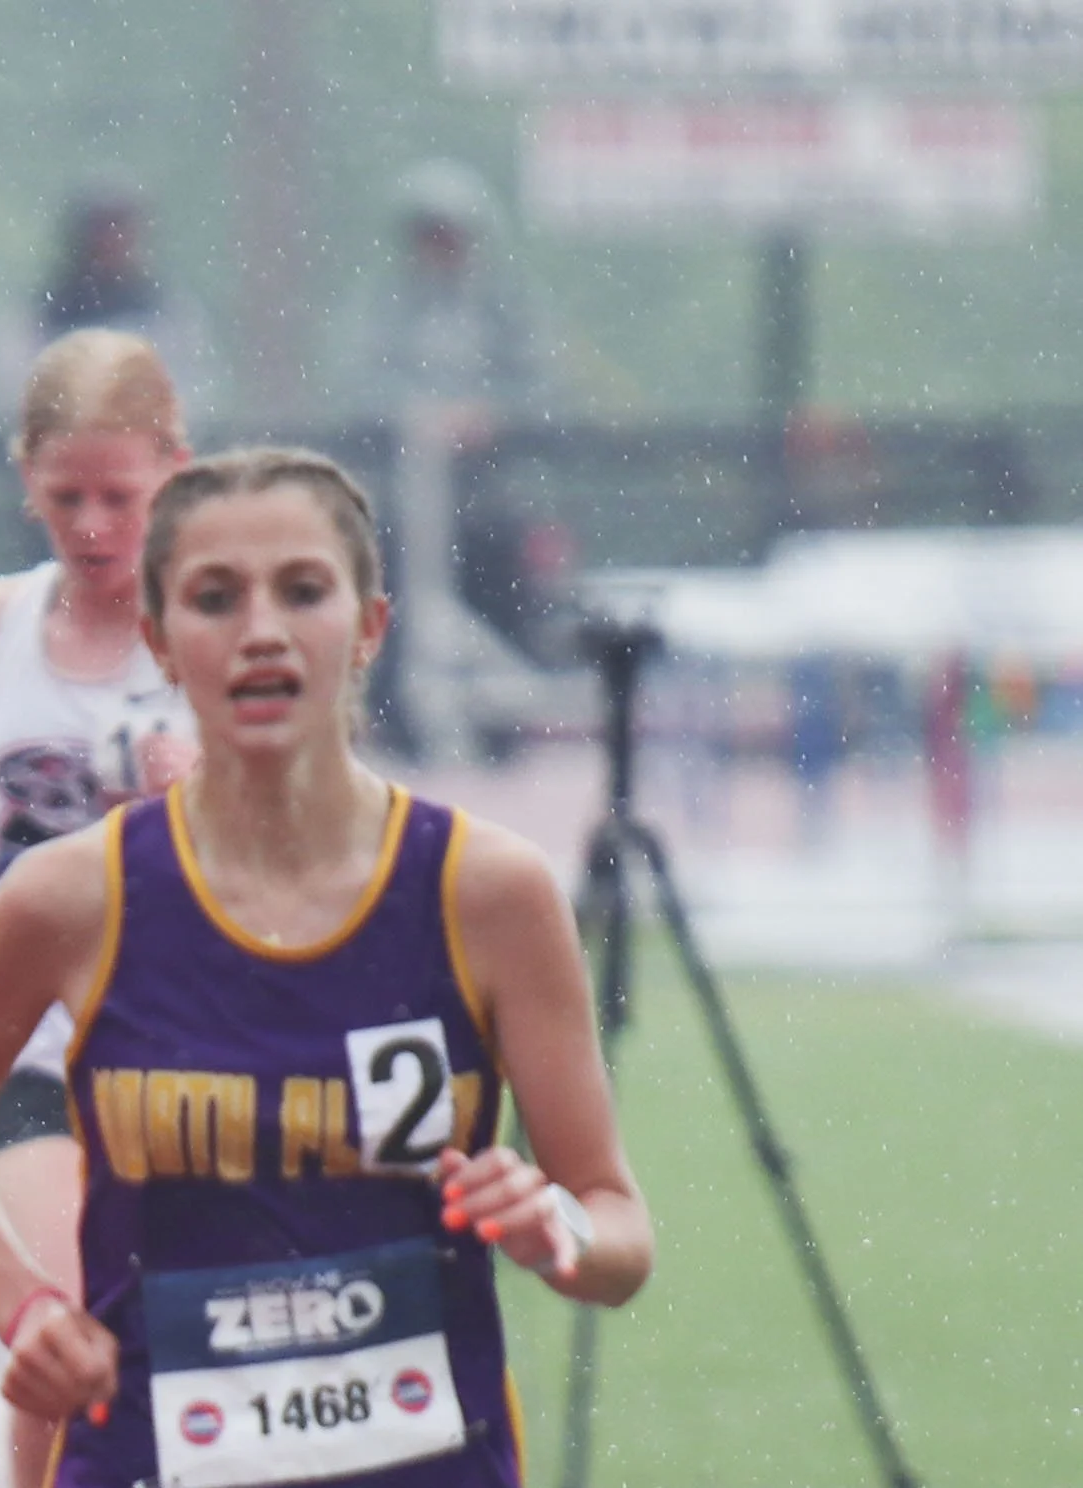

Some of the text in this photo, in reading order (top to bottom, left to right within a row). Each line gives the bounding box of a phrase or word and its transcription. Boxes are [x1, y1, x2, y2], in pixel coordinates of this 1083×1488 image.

[370, 1036, 450, 1163] 2
[206, 1281, 384, 1351] ZERO
[250, 1379, 371, 1436] 1468
